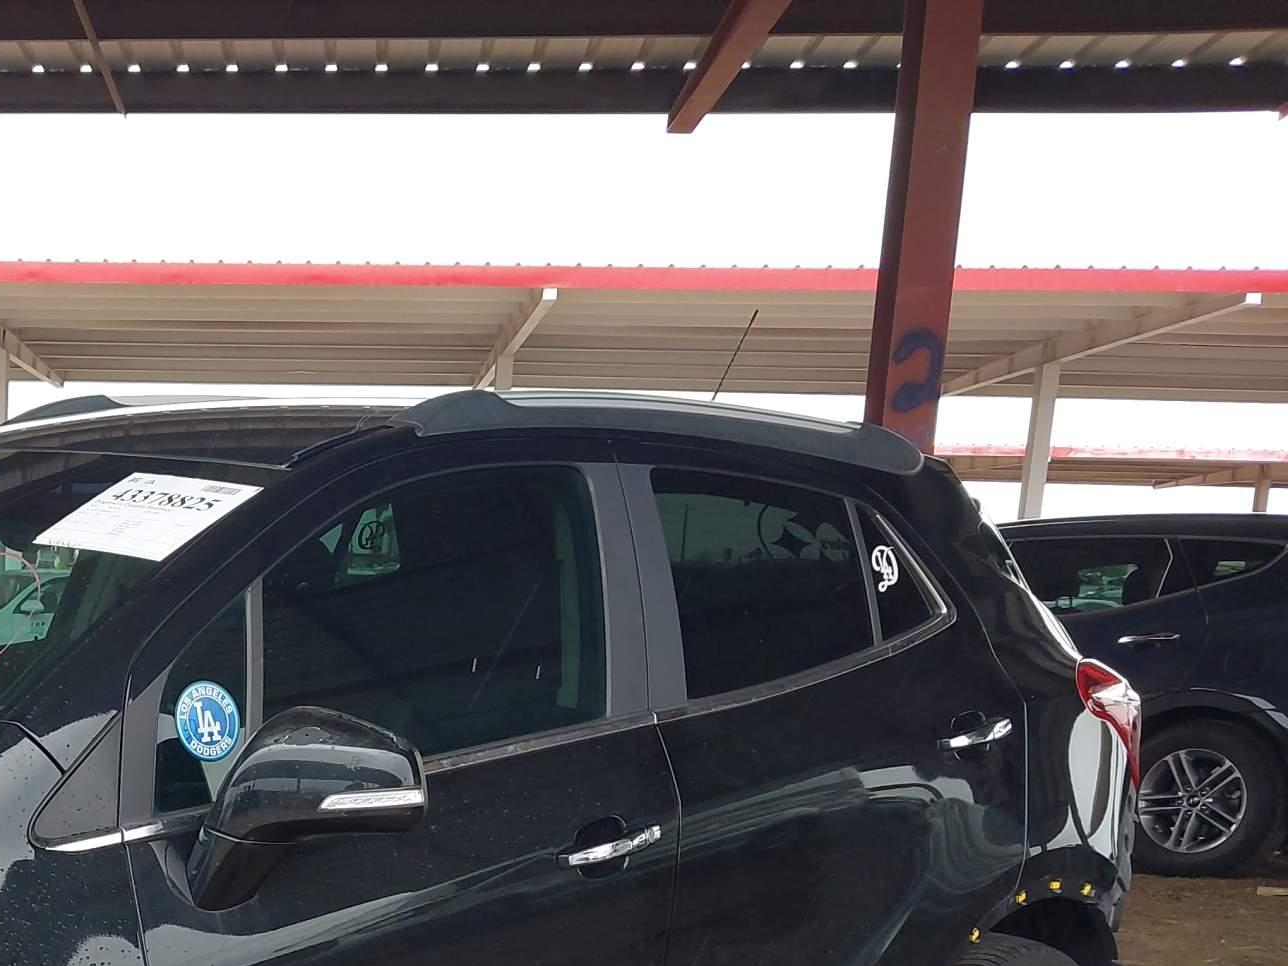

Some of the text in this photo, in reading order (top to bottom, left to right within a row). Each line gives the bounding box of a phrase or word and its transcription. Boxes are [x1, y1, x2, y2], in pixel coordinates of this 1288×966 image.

[890, 326, 943, 413] 2
[111, 488, 222, 512] 43378825
[179, 686, 233, 721] LOS ANGELES
[193, 701, 222, 743] LA
[189, 735, 233, 756] DODGERS
